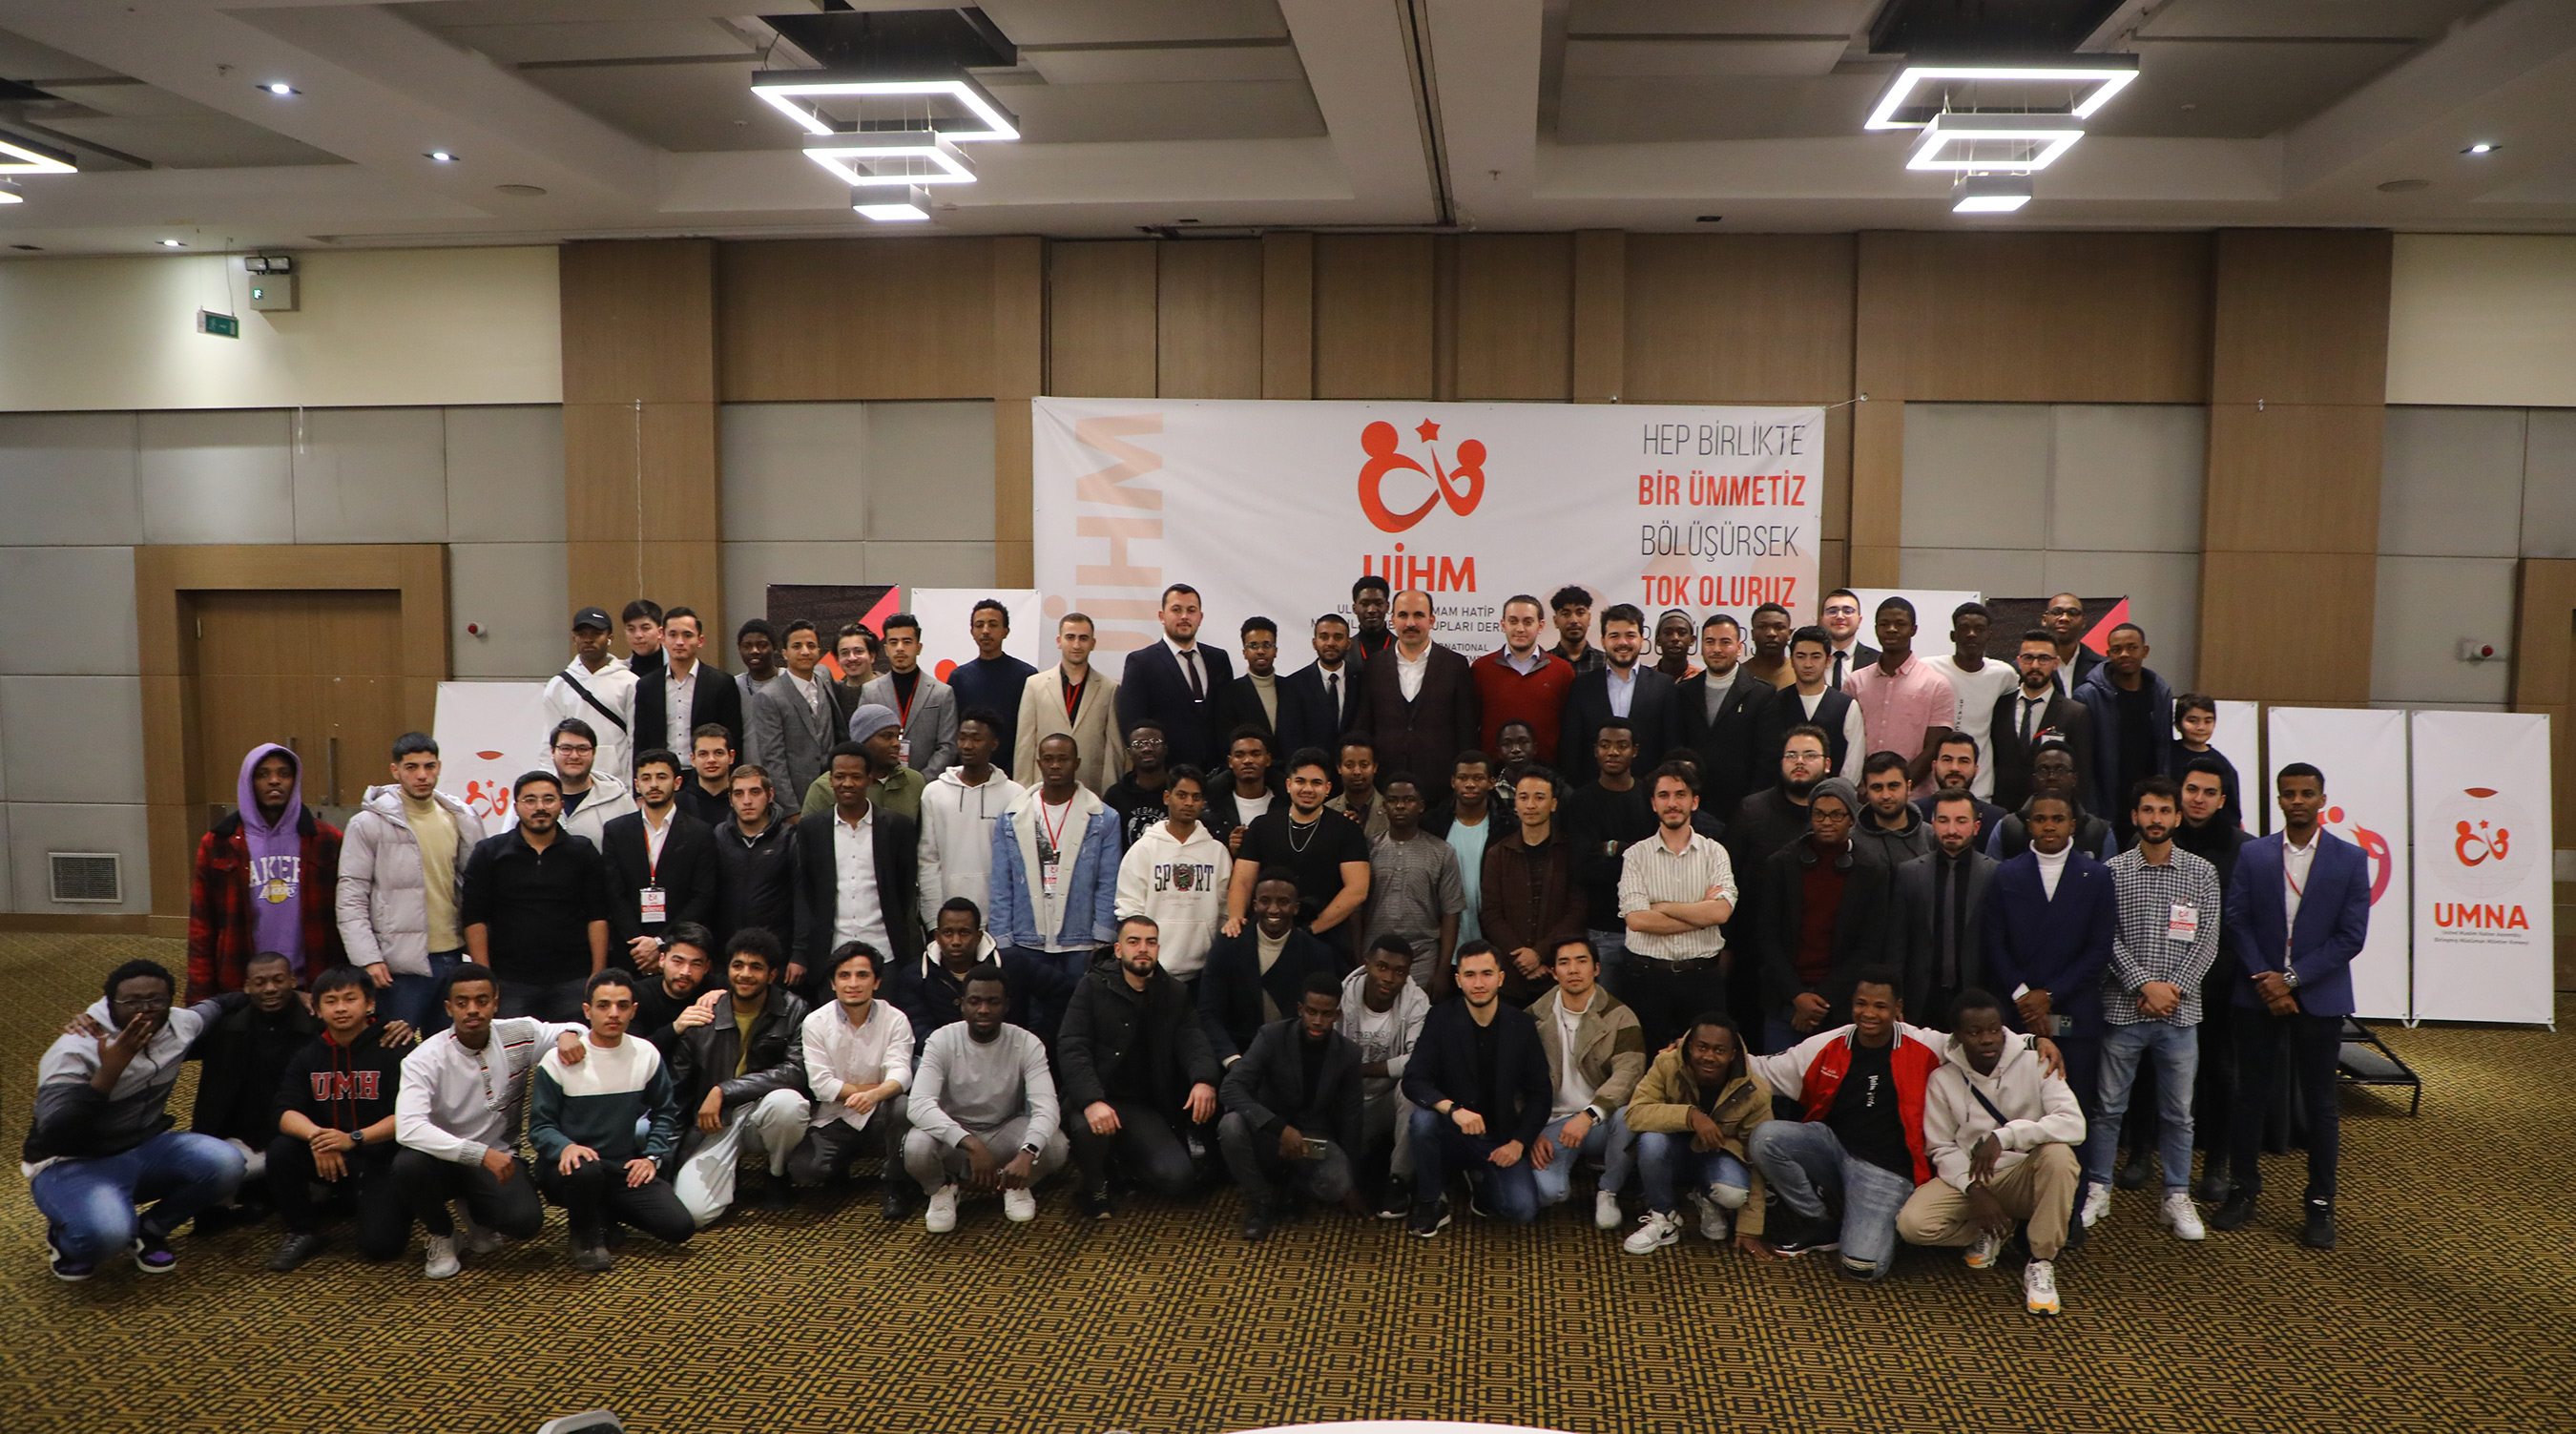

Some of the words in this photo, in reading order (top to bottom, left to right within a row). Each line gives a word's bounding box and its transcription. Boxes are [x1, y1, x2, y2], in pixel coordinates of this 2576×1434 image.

[1643, 424, 1690, 455] HEP
[1698, 420, 1806, 456] BİRLİKTE
[1638, 468, 1680, 506] BİR
[1689, 469, 1806, 507] ÜMMETİZ
[1641, 519, 1799, 562] BÖLÜŞÜRSEK
[1641, 575, 1691, 606] TOK
[1698, 575, 1797, 608] OLURUZ
[1431, 606, 1458, 616] MAM
[1462, 605, 1495, 617] HATİP
[1432, 621, 1473, 632] UPLARI
[2435, 903, 2529, 929] UMNA
[310, 1070, 381, 1101] UMH
